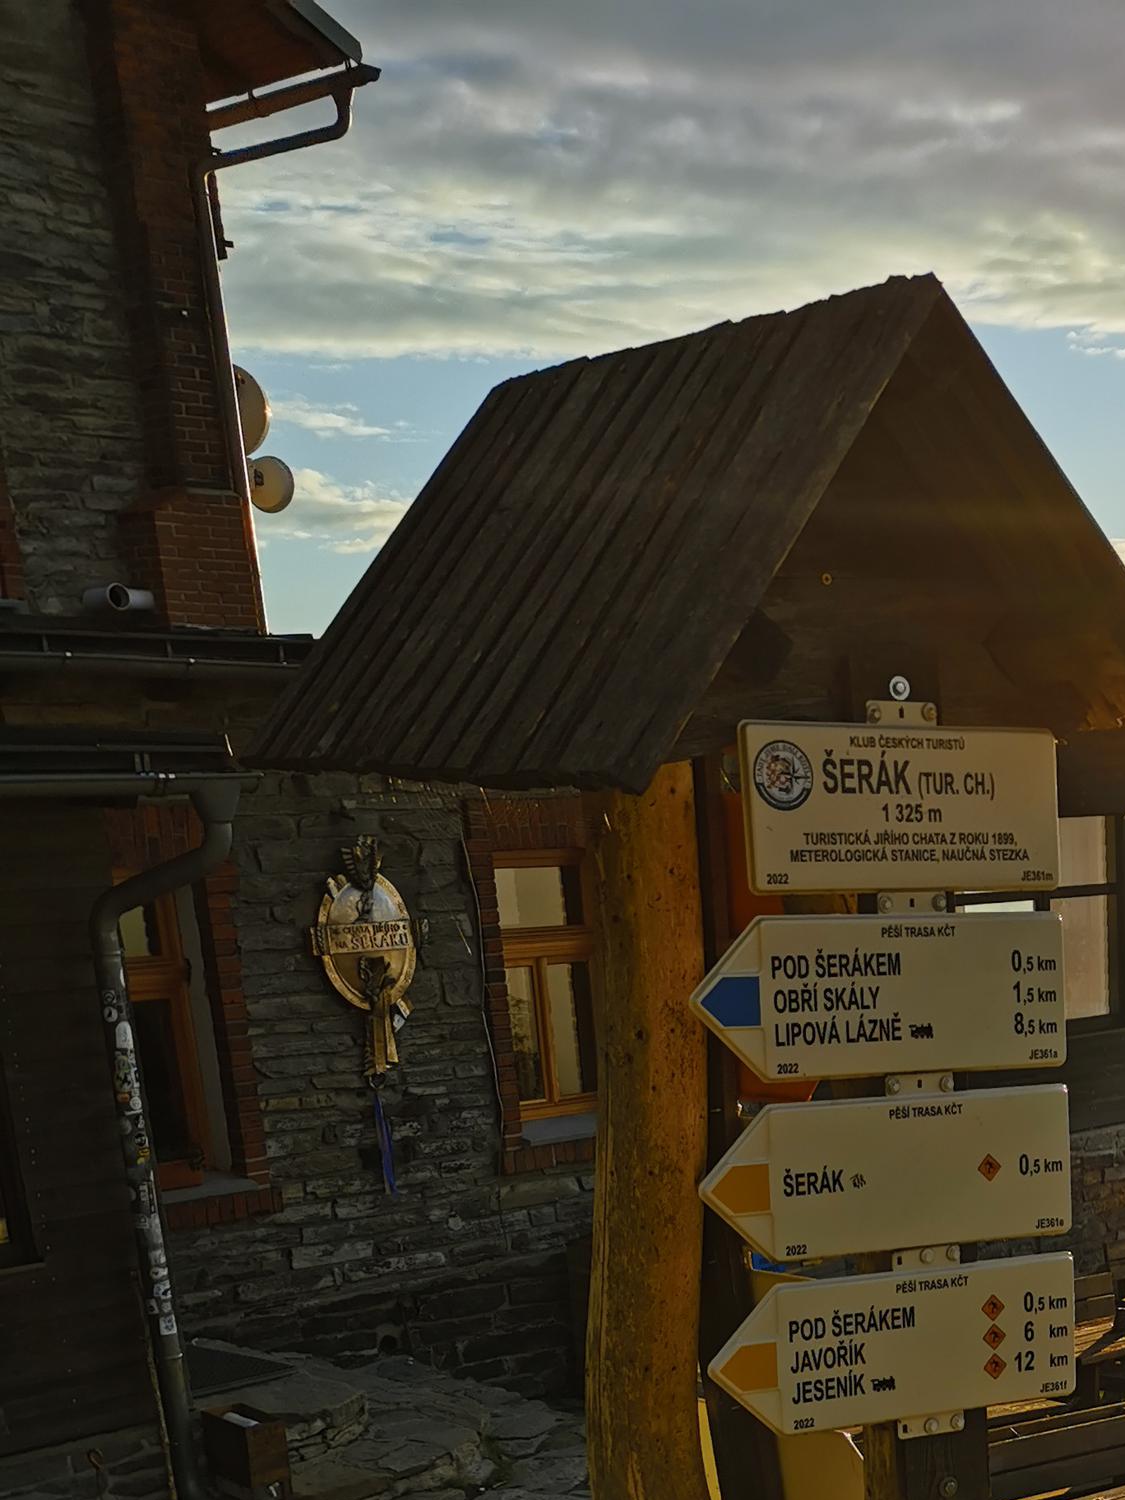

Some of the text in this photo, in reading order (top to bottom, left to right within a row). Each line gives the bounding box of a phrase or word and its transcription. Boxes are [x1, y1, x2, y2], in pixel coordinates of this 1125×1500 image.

[850, 736, 876, 748] KLUB
[878, 734, 924, 751] ČESKÝCH
[822, 749, 912, 794] ŠERÁK
[918, 772, 959, 800] (TUR.
[964, 772, 994, 800] CH.)
[896, 803, 923, 822] 325
[928, 808, 942, 822] m
[803, 829, 1017, 846] TURISTICKÁ JIŘÍHO CHATA Z ROKU 1899,
[790, 846, 1029, 862] METEROLOGICKÁ STANICE, NAUČNÁ STEZKA
[767, 873, 789, 885] 2022
[881, 923, 955, 938] PĚŠÍ TRASA KČT
[771, 948, 901, 979] POD ŠERÁKEM
[1012, 950, 1056, 974] 0,5 km
[774, 981, 880, 1014] OBŘÍ SKÁLY
[1013, 981, 1056, 1005] 1,5 km
[775, 1012, 902, 1047] LIPOVÁ LÁZNĚ
[1014, 1012, 1057, 1037] 8,5 km
[777, 1063, 799, 1074] 2022
[889, 1102, 962, 1119] PĚŠÍ TRASA KČT
[1019, 1154, 1062, 1176] 0,5 km
[783, 1165, 844, 1197] ŠERÁK
[786, 1244, 809, 1259] 2022
[896, 1274, 968, 1293] PĚŠÍ TRASA KČT
[1024, 1292, 1067, 1314] 0,5 km
[789, 1305, 915, 1343] POD ŠERÁKEM
[1024, 1321, 1067, 1342] 6 km
[790, 1341, 866, 1376] JAVOŘÍK
[1014, 1351, 1068, 1372] 12 km
[791, 1369, 865, 1404] JESENÍK
[794, 1417, 816, 1432] 2022
